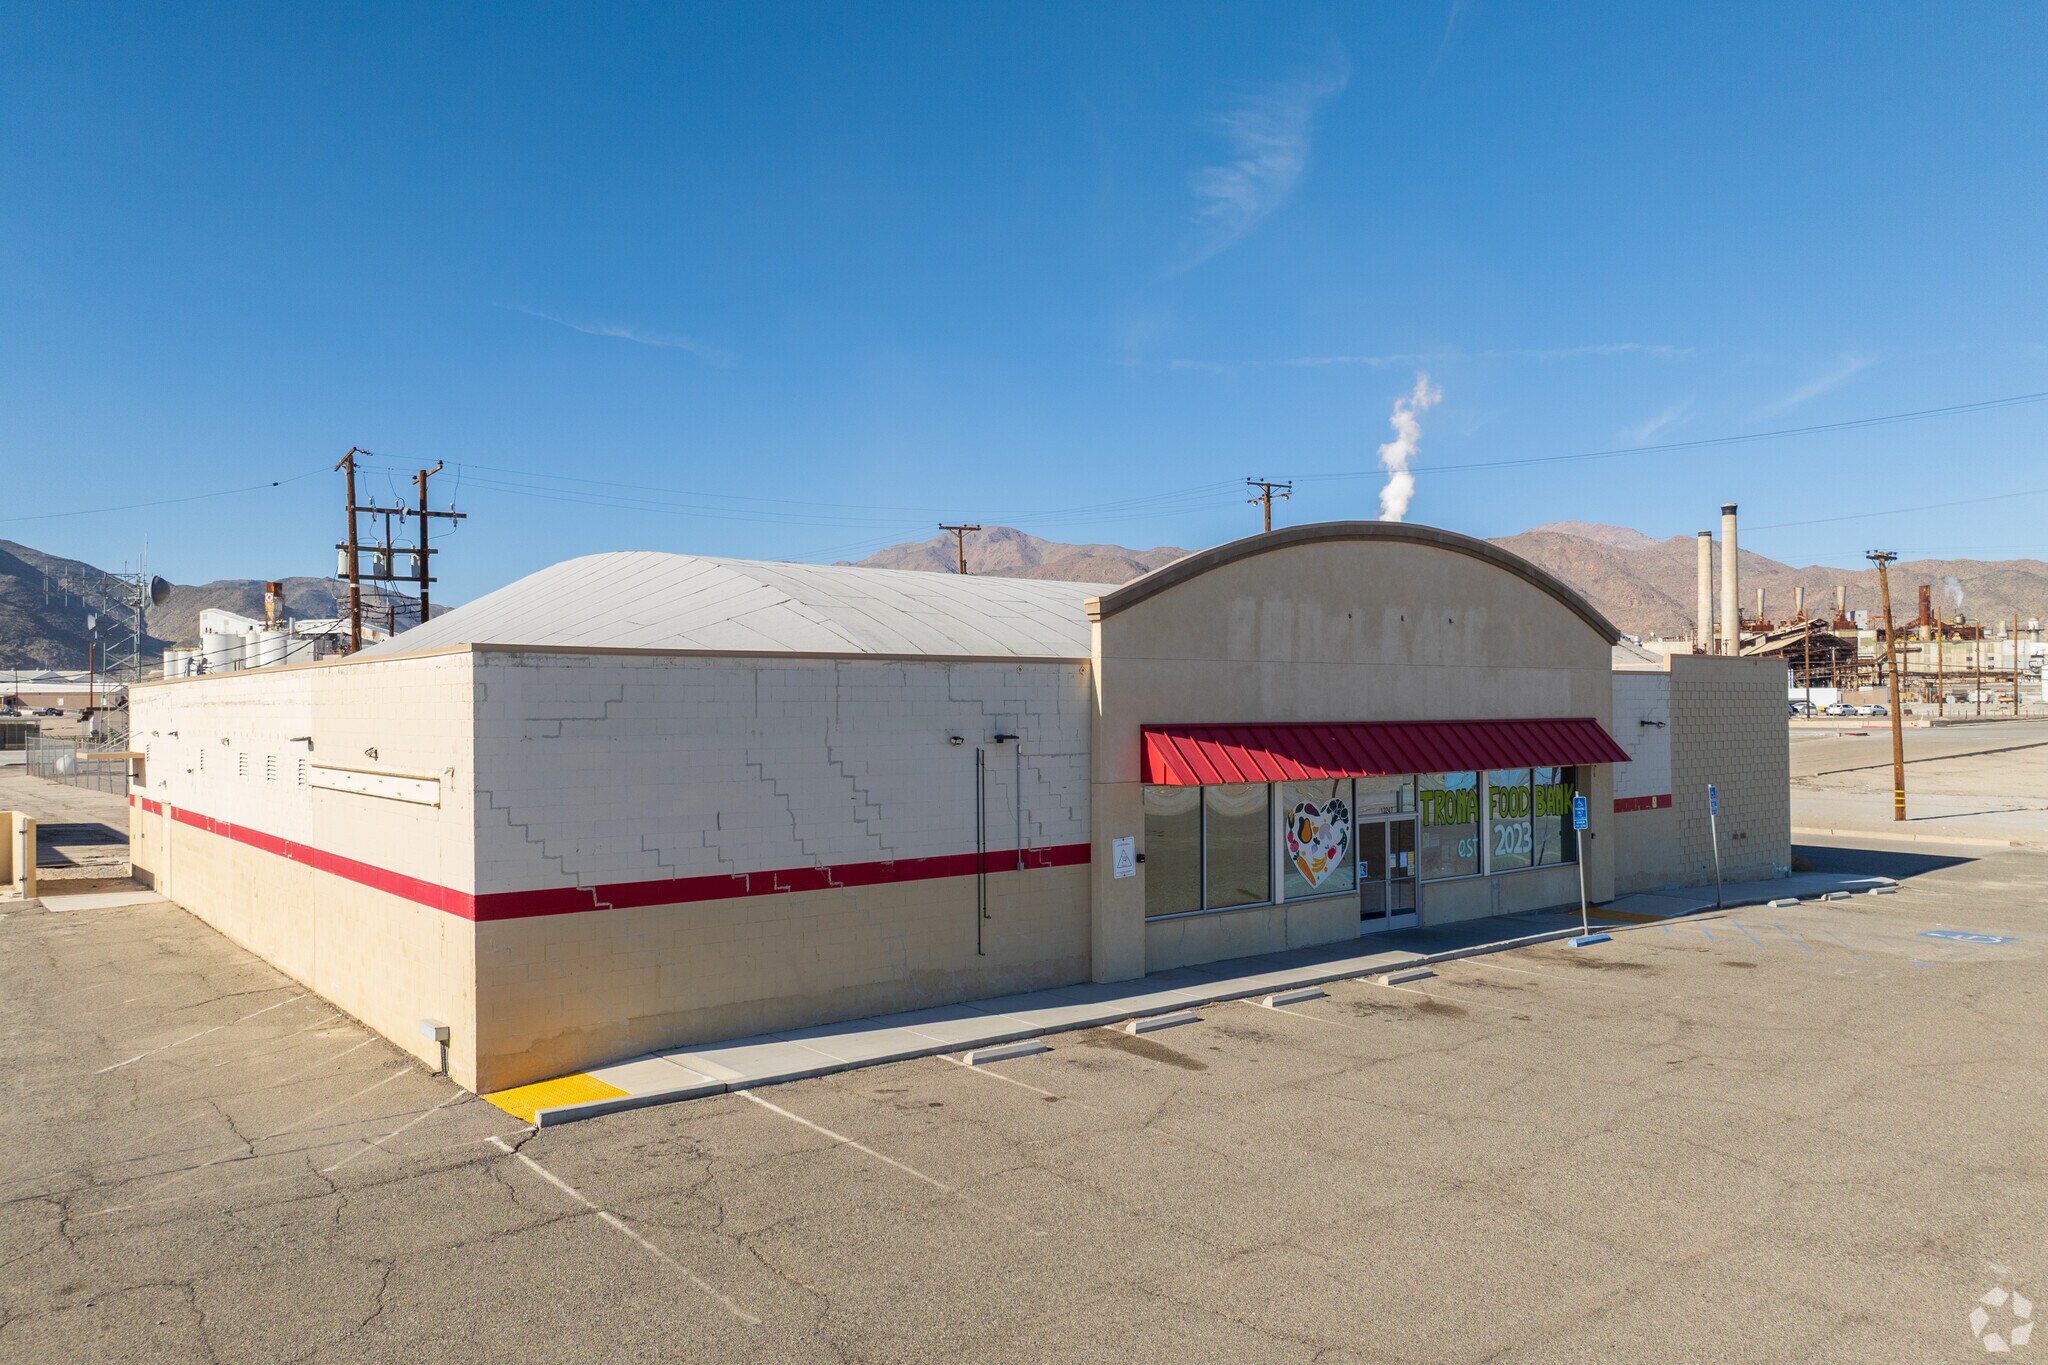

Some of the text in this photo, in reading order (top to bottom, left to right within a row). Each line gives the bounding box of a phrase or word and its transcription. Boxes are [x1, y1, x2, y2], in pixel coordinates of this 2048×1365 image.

[1419, 783, 1574, 827] TRONA FOOD BANK
[1458, 822, 1532, 858] est 2023
